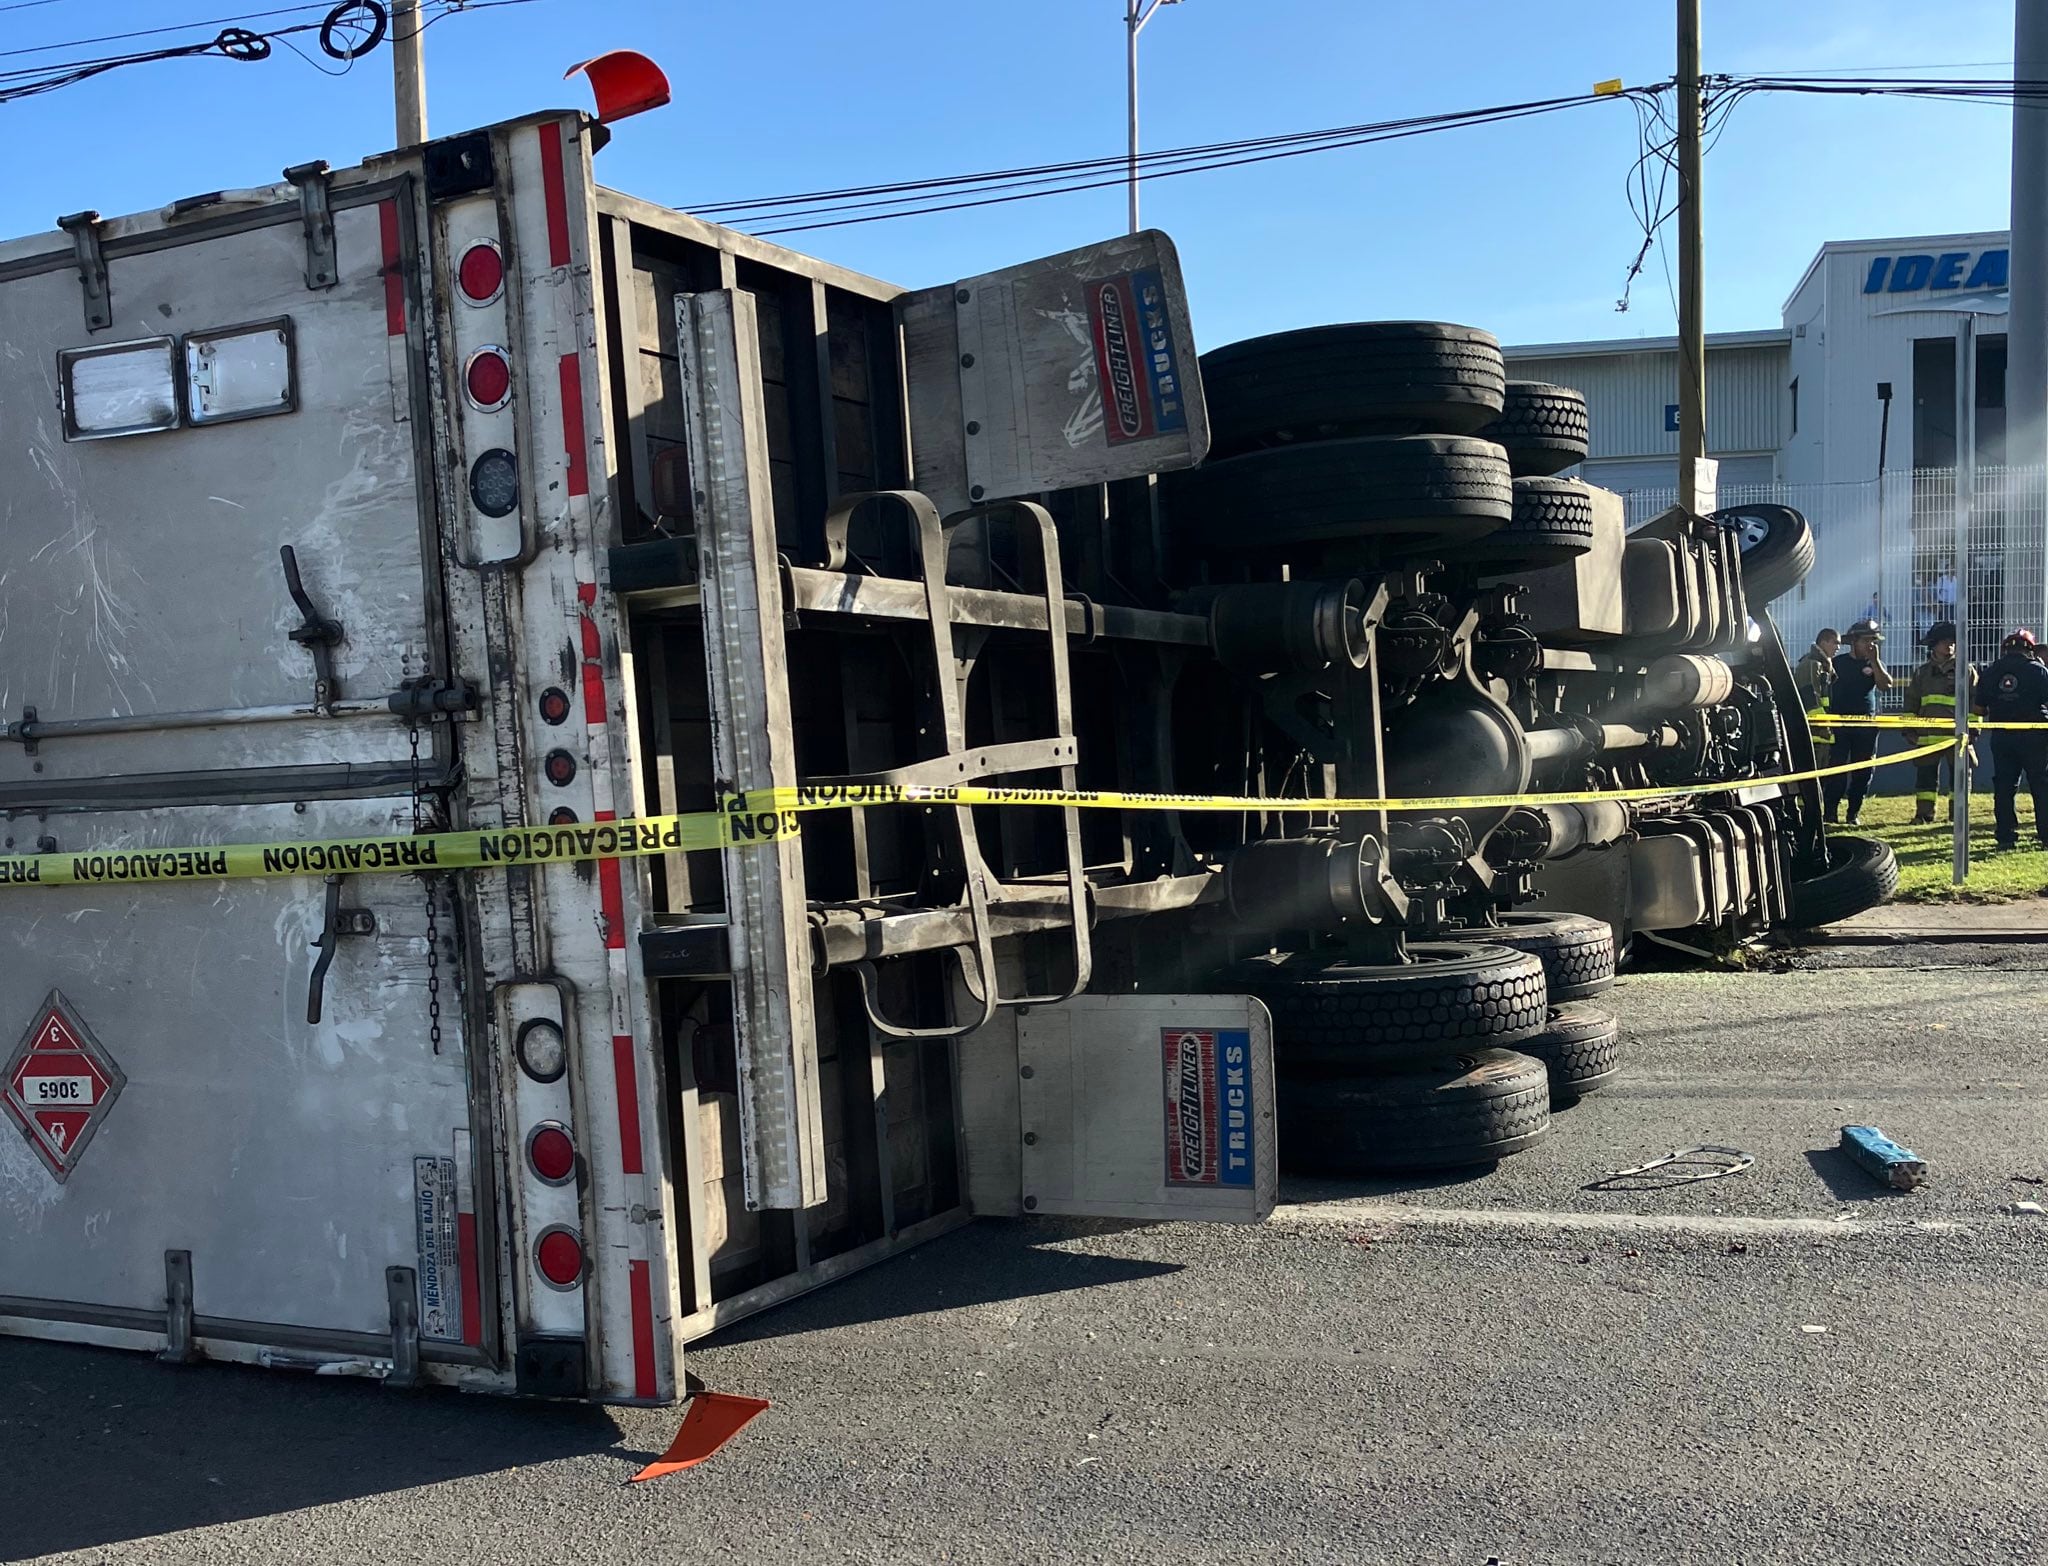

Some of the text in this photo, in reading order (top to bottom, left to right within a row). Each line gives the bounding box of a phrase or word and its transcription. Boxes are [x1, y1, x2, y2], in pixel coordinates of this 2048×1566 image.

[1864, 250, 2009, 294] IDEA
[1103, 291, 1137, 426] FREIGHTLINER
[1142, 285, 1177, 417] TRUCKS
[263, 839, 437, 874] PRECAUCIÓN
[480, 821, 682, 863] PRECAUCIÓN
[73, 851, 228, 882] PRECAUCIÓN
[50, 1026, 60, 1042] 3
[38, 1081, 79, 1099] 3065
[1181, 1041, 1200, 1171] FREIGHTLINER
[1226, 1046, 1246, 1170] TRUCKS
[425, 1227, 435, 1249] DEL
[426, 1252, 440, 1308] MENDOZA
